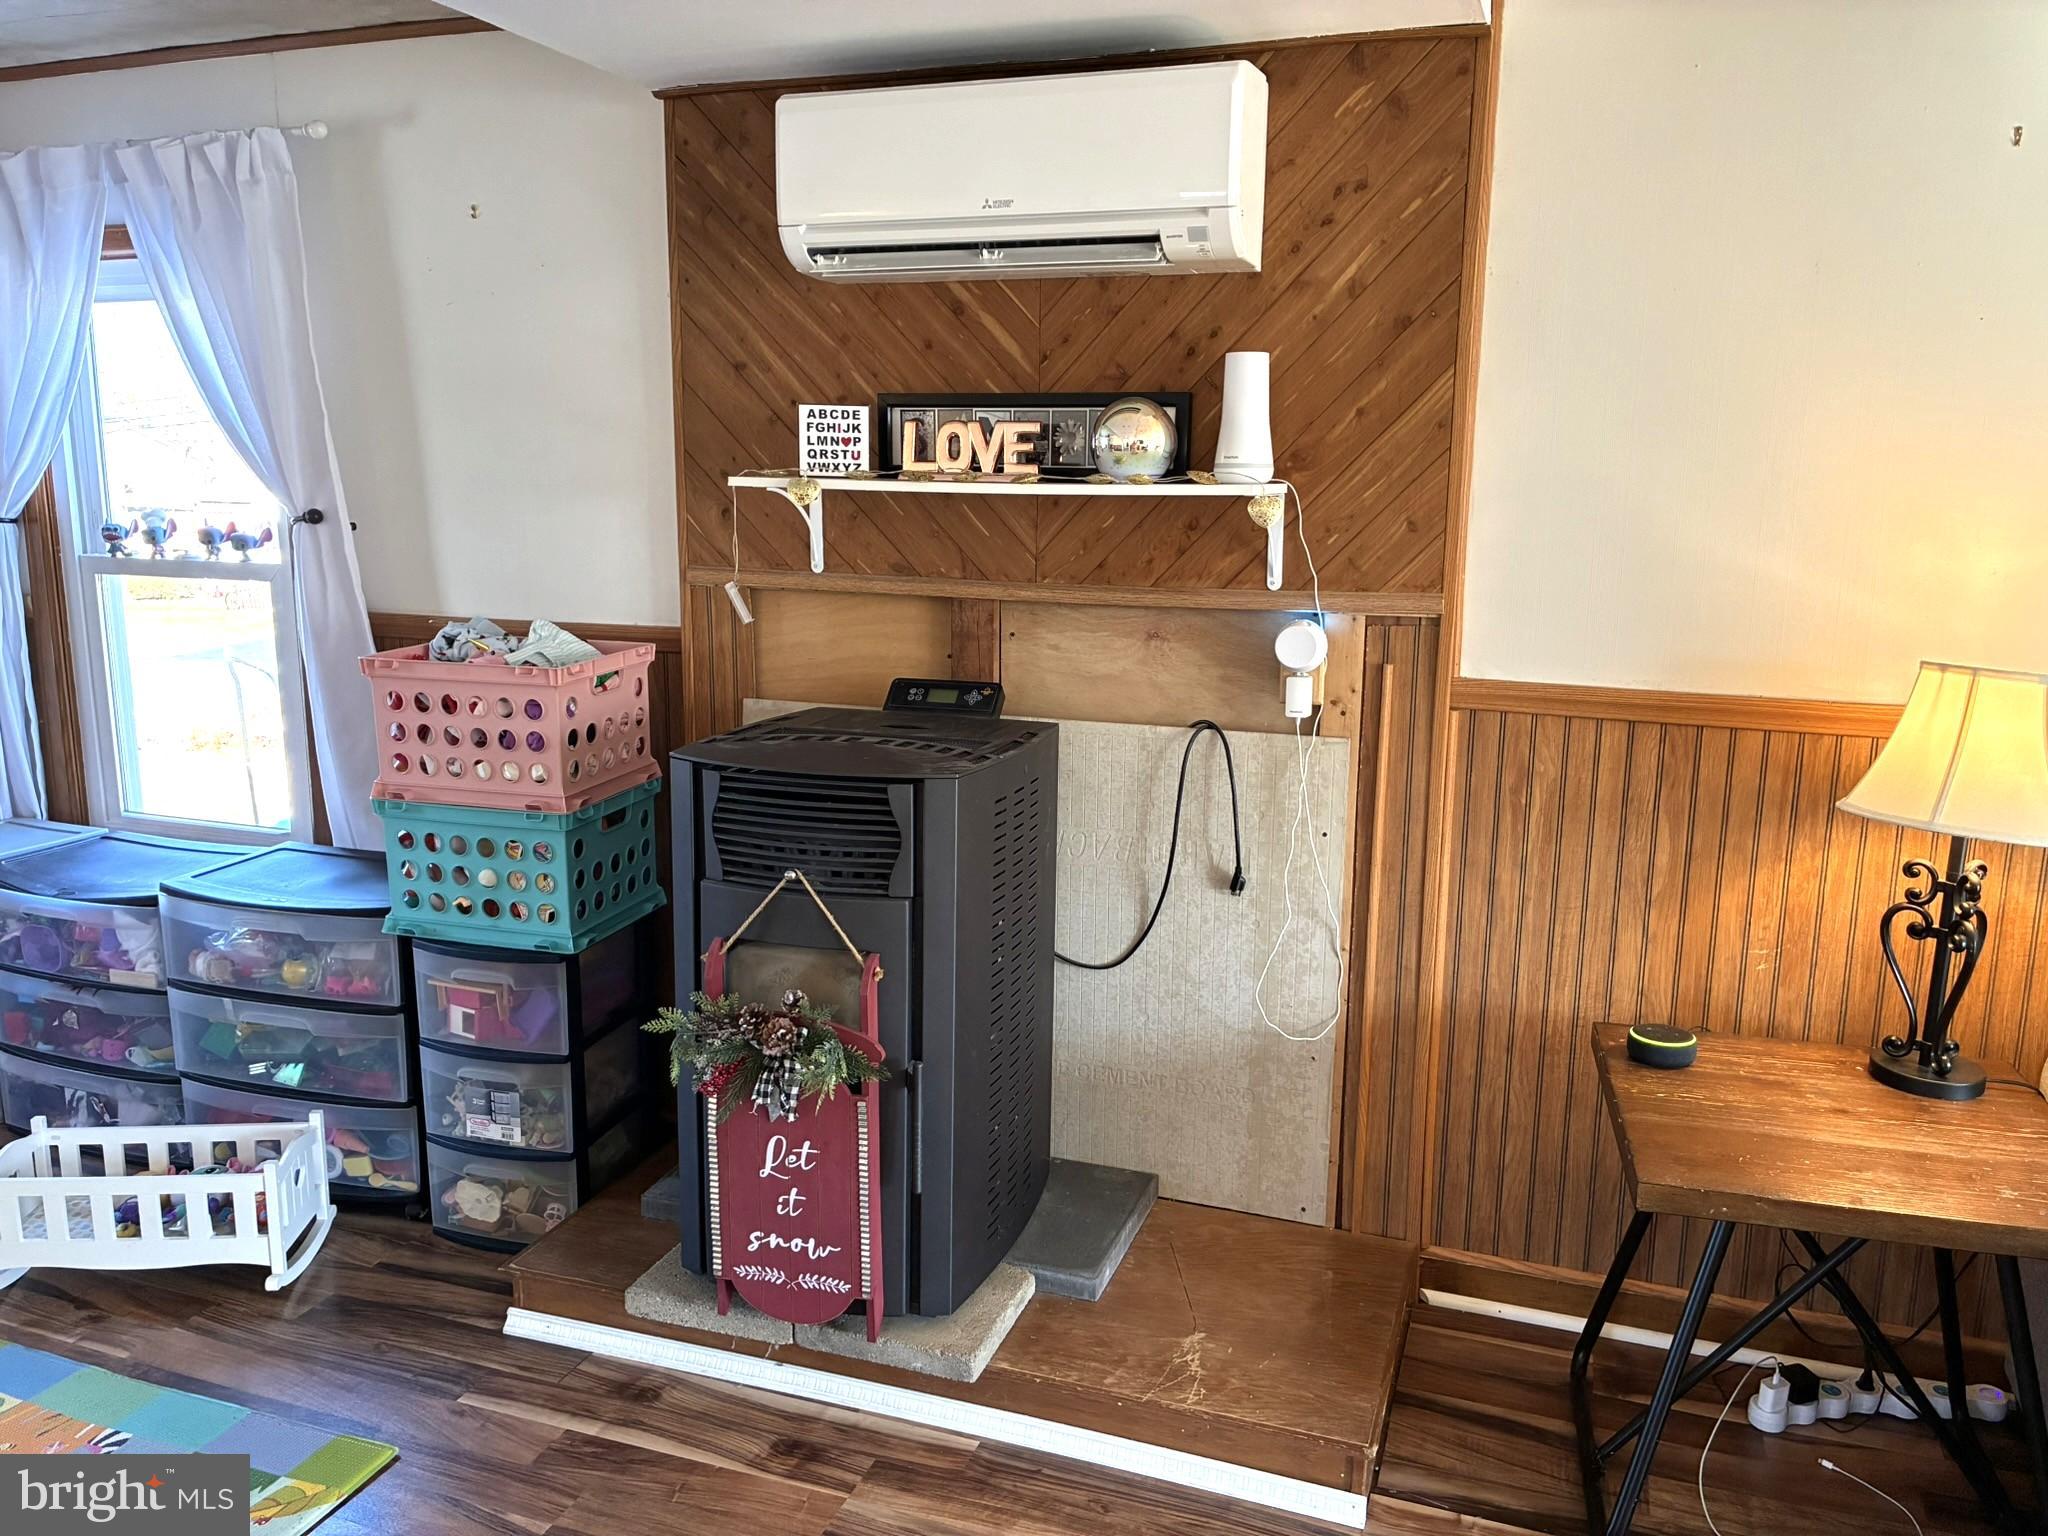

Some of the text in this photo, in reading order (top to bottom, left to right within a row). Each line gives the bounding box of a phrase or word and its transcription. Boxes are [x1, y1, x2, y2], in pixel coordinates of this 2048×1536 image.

[902, 418, 1042, 475] LOVE
[1076, 1062, 1168, 1091] CEMENT
[1174, 1078, 1256, 1105] BOARD
[759, 1134, 821, 1180] Let
[776, 1187, 807, 1217] it
[747, 1230, 842, 1261] snow
